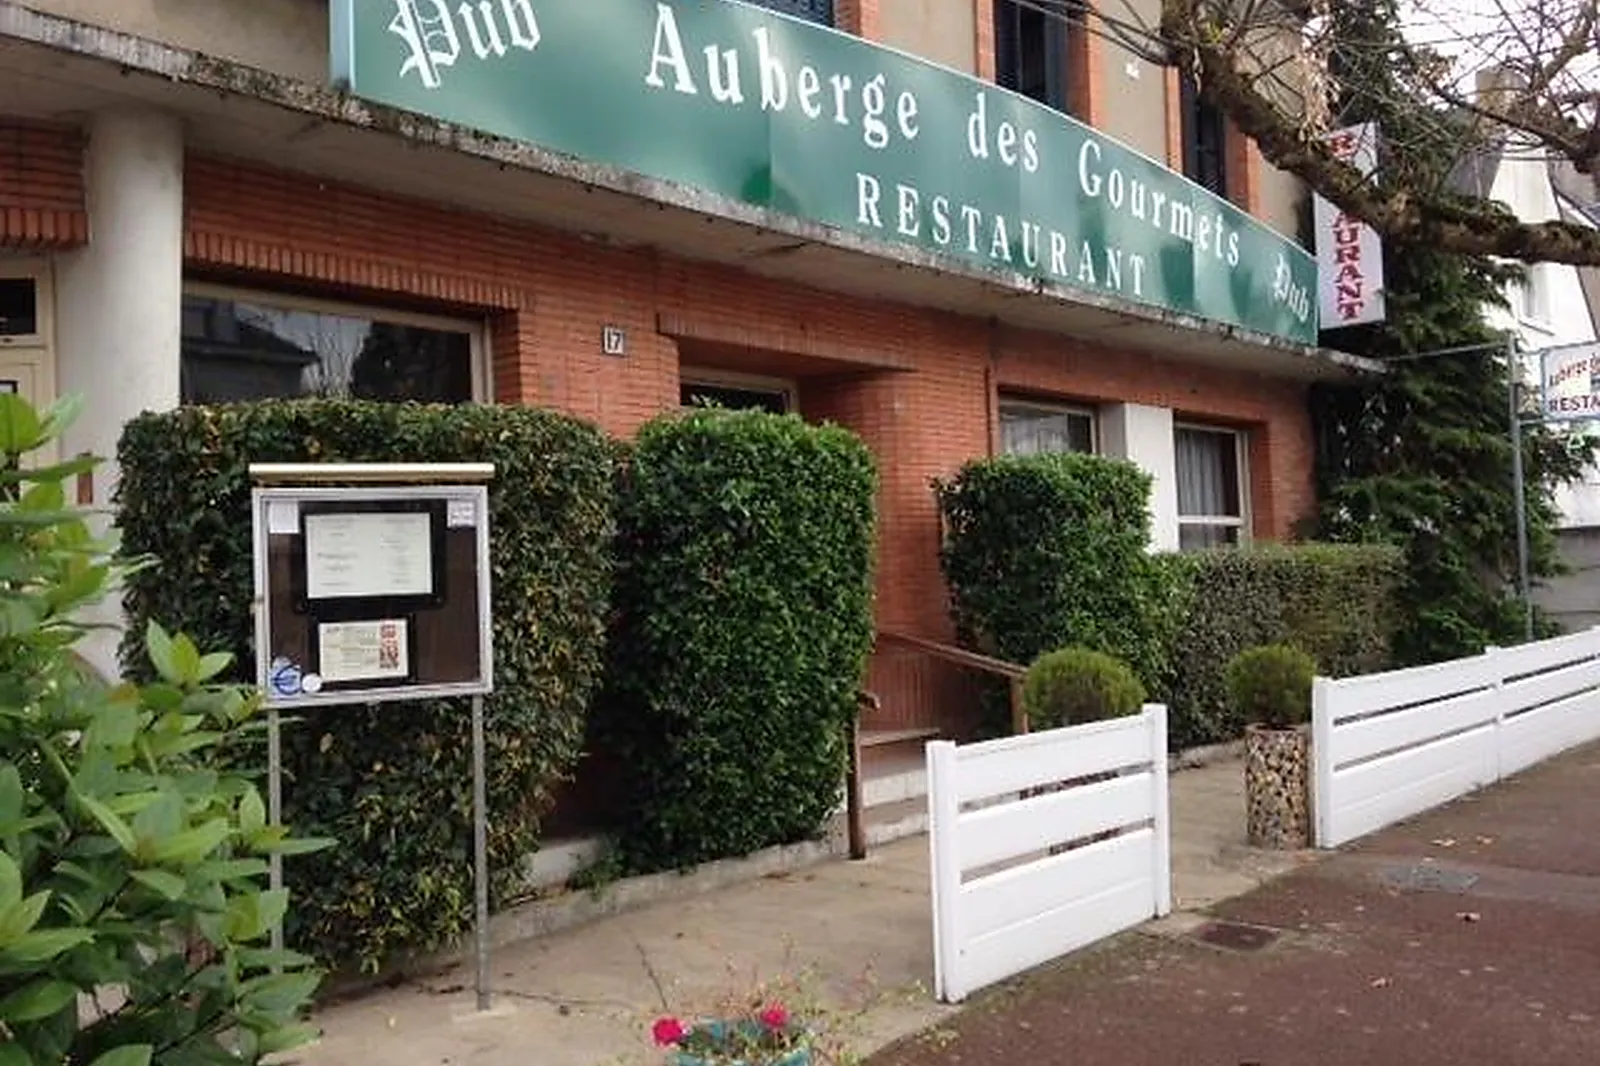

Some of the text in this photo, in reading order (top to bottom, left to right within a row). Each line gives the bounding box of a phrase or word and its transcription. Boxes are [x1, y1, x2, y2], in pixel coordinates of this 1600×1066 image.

[388, 0, 541, 88] Pub
[645, 2, 1240, 268] Auberge des Gourmets
[856, 172, 1147, 297] RESTAURANT
[1272, 252, 1310, 323] Pub
[607, 330, 621, 350] 17
